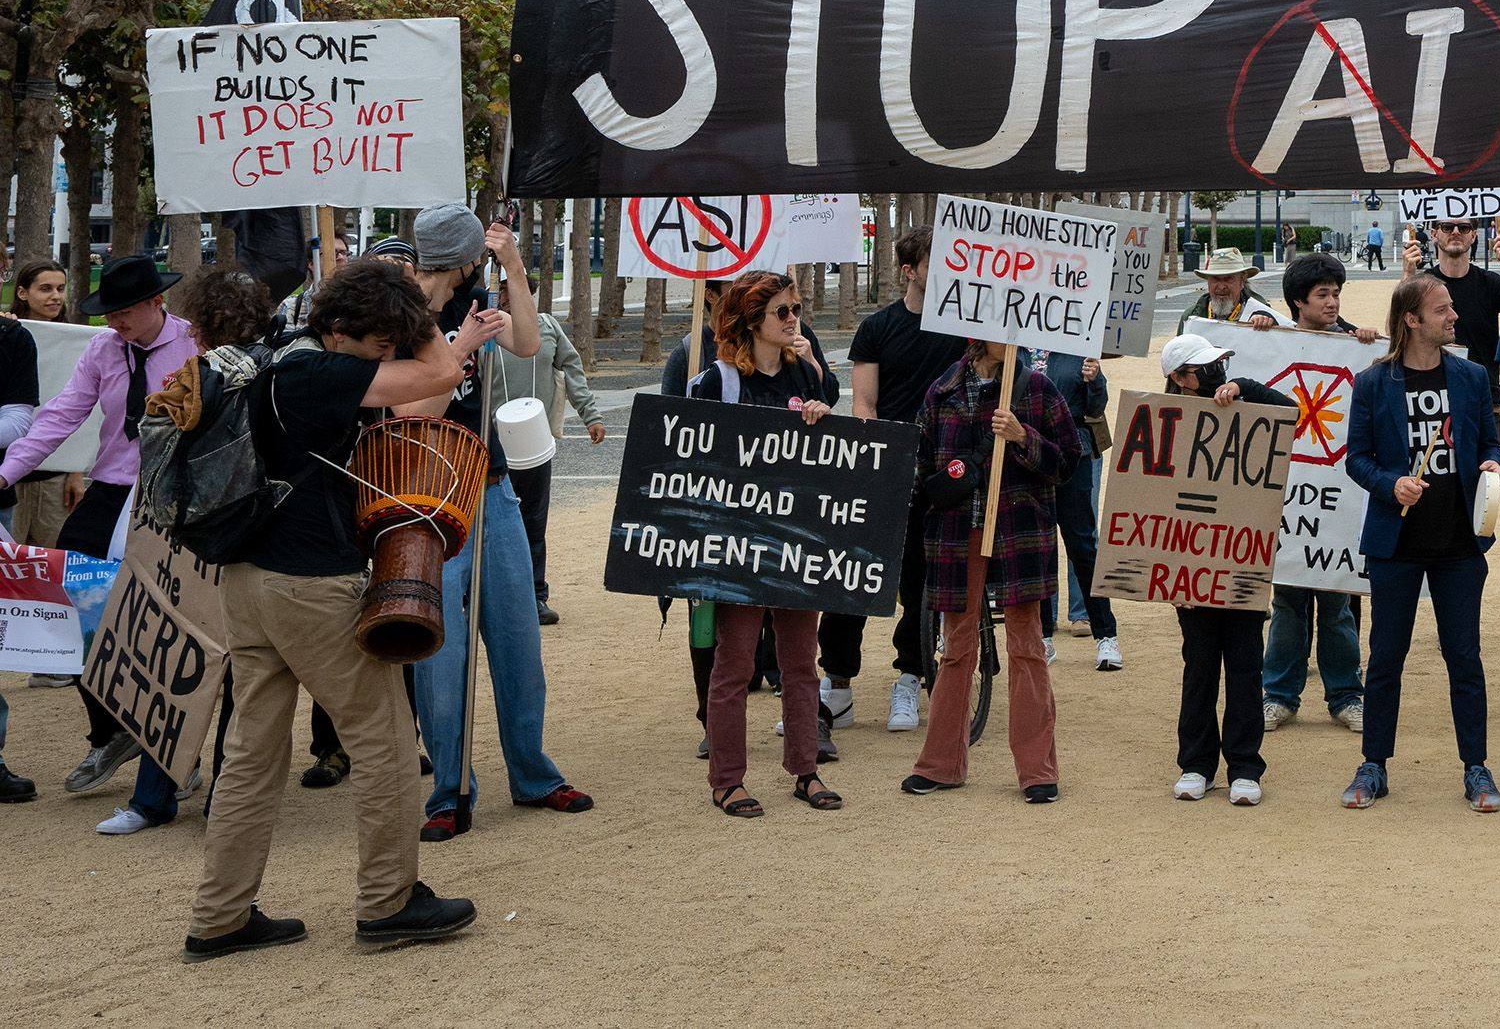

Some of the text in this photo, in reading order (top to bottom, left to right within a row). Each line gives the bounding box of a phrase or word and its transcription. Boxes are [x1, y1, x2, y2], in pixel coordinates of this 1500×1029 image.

[177, 32, 377, 73] IF NO ONE
[214, 75, 365, 105] BUILDS IT
[1251, 6, 1465, 174] AI
[197, 98, 423, 144] IT DOES NOT
[232, 132, 413, 187] GET BUILT
[647, 197, 747, 253] ASI
[788, 207, 835, 224] emmings)
[941, 200, 1116, 252] AND HONESTLY?
[1401, 197, 1438, 220] WE
[1123, 227, 1149, 248] AI
[945, 238, 1035, 282] STOP
[1050, 262, 1088, 289] the
[1124, 250, 1150, 269] YOU
[1125, 274, 1144, 294] IS
[938, 279, 992, 324] AI
[1003, 288, 1101, 341] RACE!
[1109, 301, 1142, 321] EVE
[1405, 389, 1450, 416] TO
[663, 414, 887, 469] YOU WOULDN'T
[1116, 404, 1298, 490] AI RACE
[1407, 420, 1446, 448] HE
[1408, 448, 1457, 477] AC
[649, 472, 867, 524] DOWNLOAD THE
[0, 542, 48, 560] VE
[67, 555, 88, 565] this
[621, 523, 884, 594] TORMENT NEXUS
[1108, 512, 1275, 567] EXTINCTION
[66, 572, 93, 582] from
[1148, 563, 1231, 605] RACE
[10, 606, 30, 616] On
[32, 608, 68, 621] Signal
[115, 571, 205, 695] NERD
[87, 627, 187, 769] REICH
